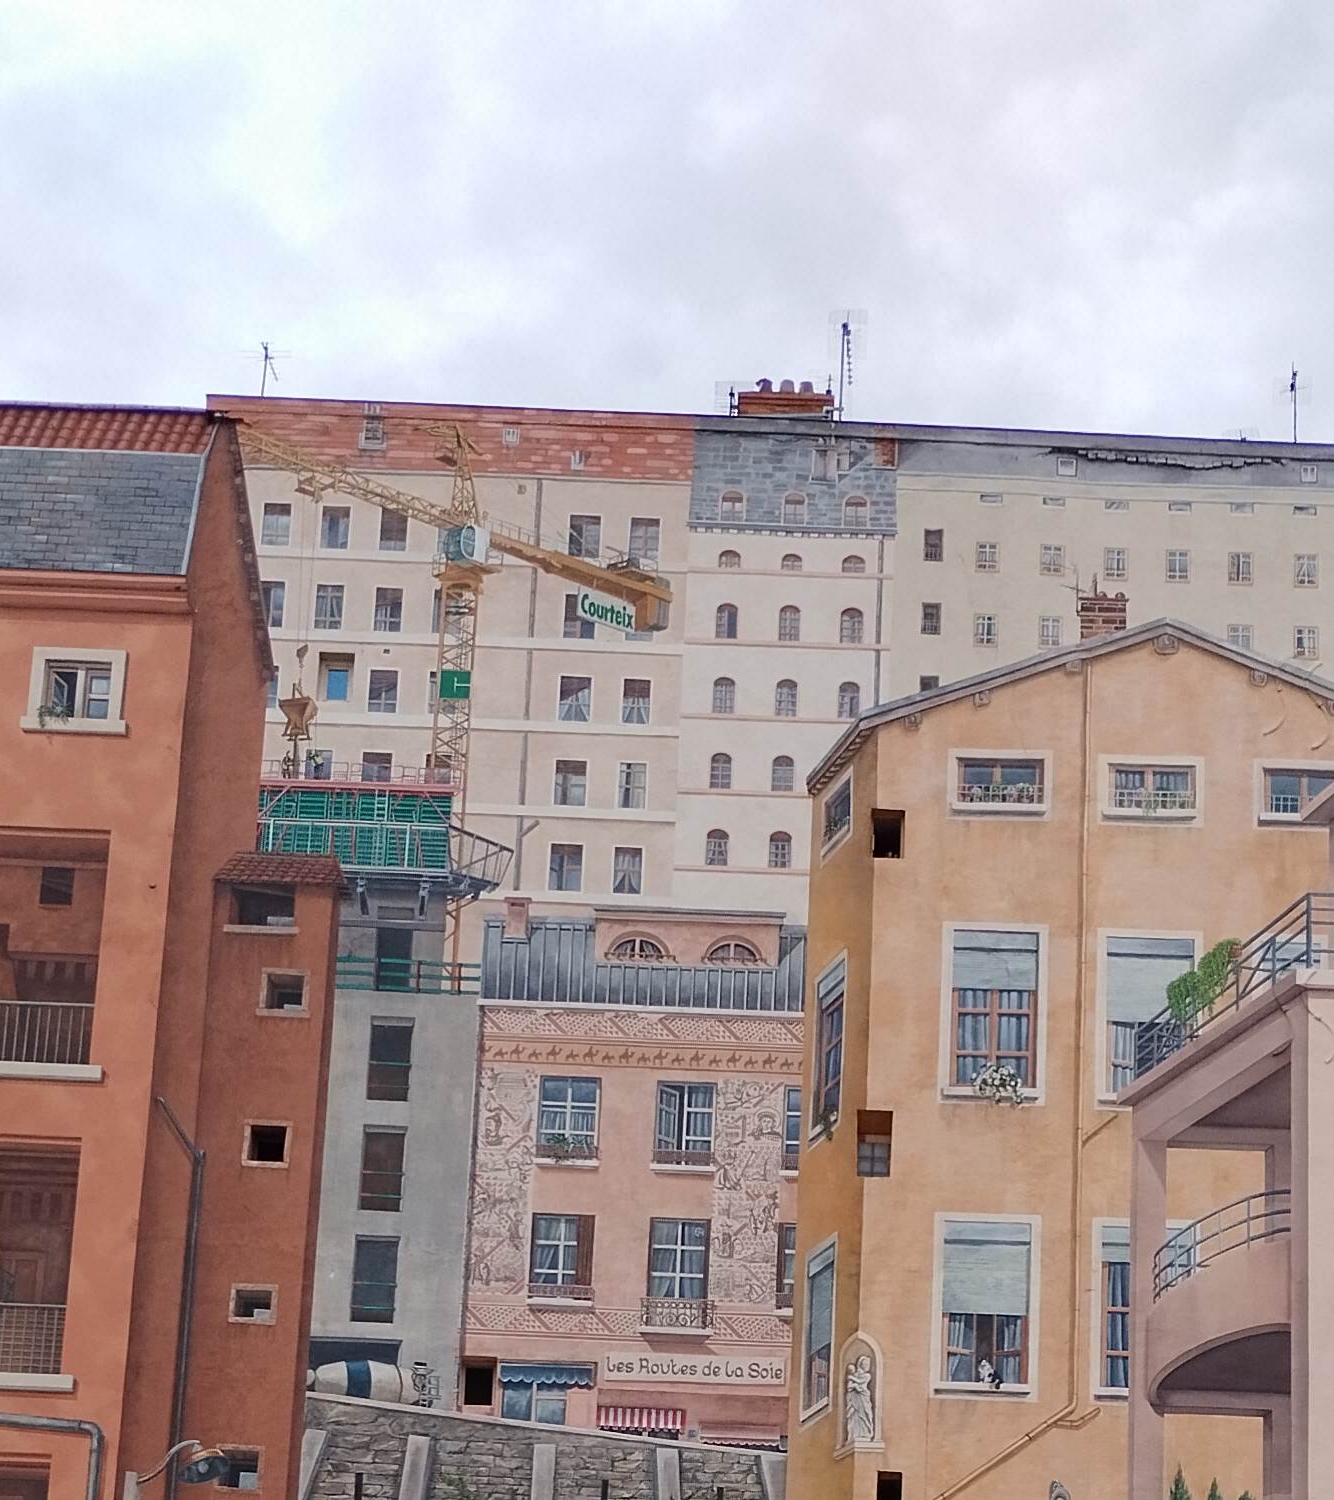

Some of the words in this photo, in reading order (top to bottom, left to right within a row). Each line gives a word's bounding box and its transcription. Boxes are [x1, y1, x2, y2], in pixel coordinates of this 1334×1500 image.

[581, 593, 634, 629] Courteix
[606, 1356, 634, 1373] Les
[639, 1357, 697, 1376] Routes
[702, 1361, 720, 1377] de
[748, 1361, 783, 1379] Soie
